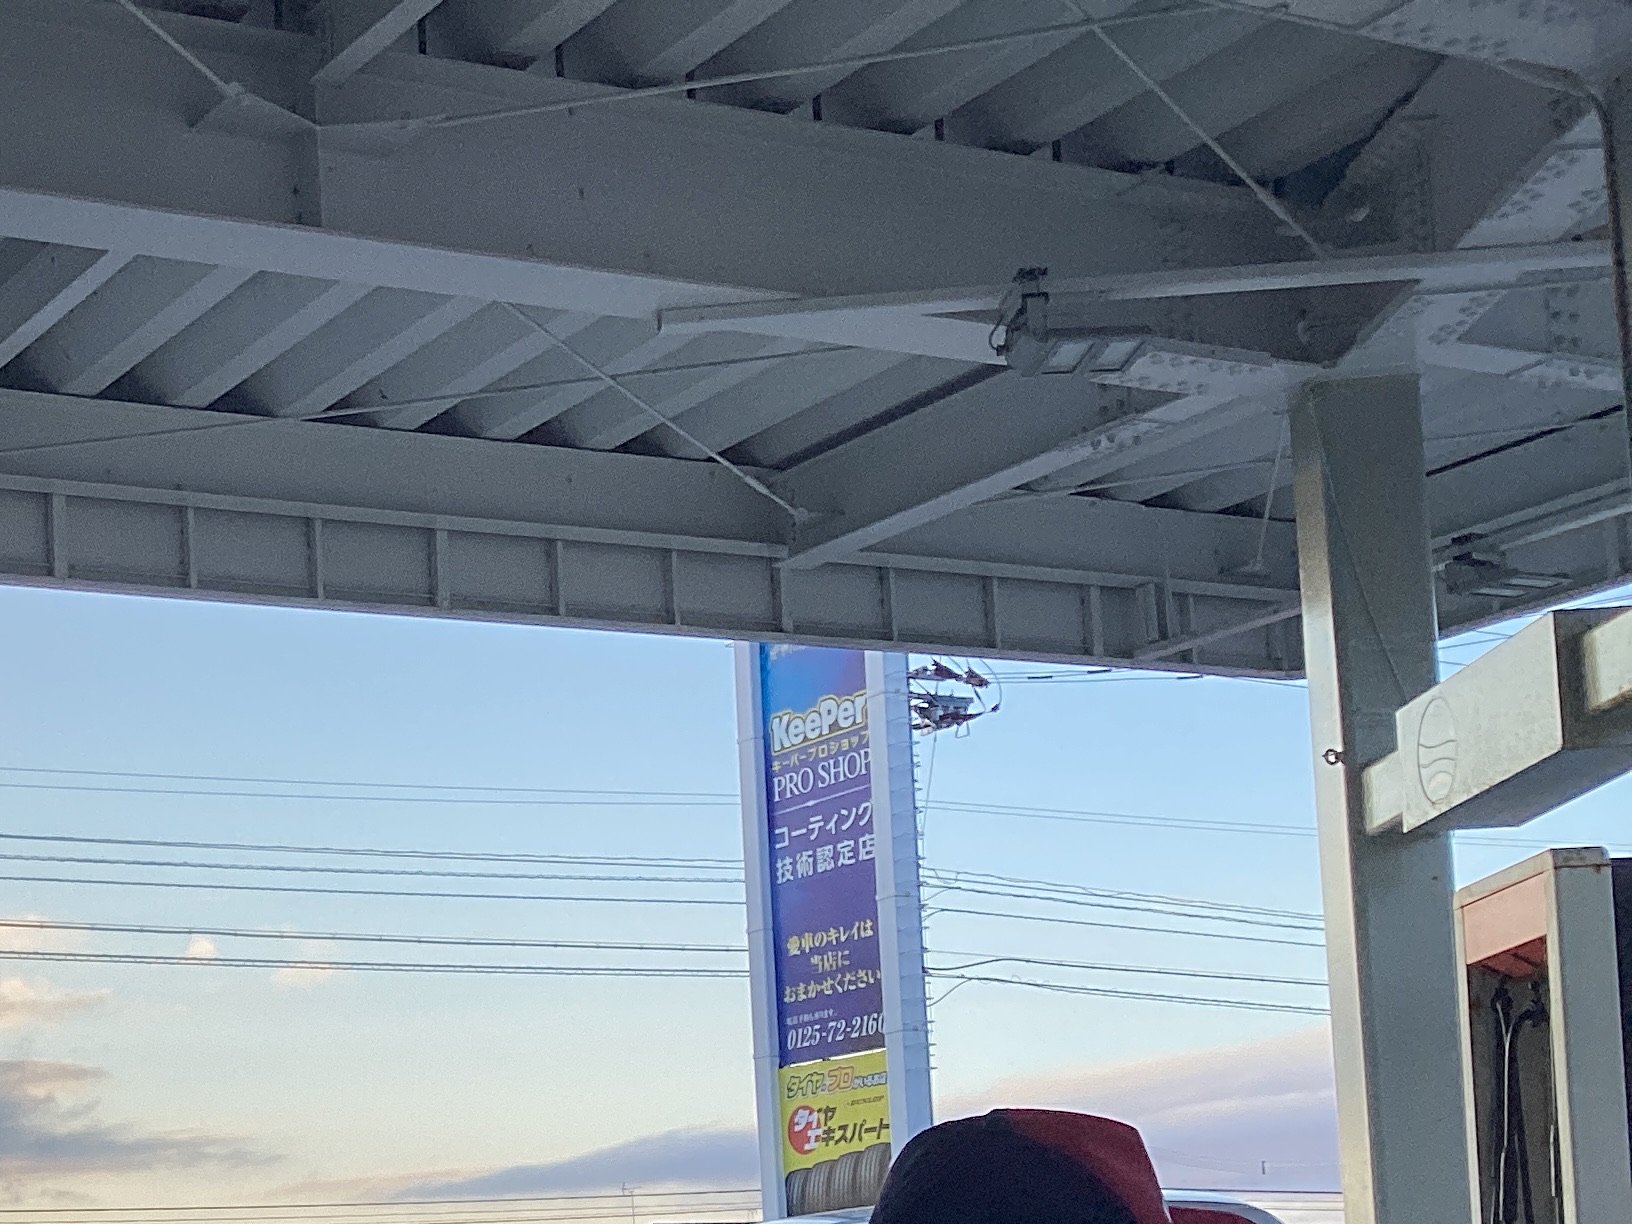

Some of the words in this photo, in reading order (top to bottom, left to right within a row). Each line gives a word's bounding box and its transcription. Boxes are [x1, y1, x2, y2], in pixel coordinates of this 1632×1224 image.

[770, 691, 868, 754] KeePer
[773, 767, 814, 802] PRO
[818, 748, 871, 789] SHOP
[774, 801, 873, 849] コーティング
[776, 834, 876, 885] 技術認定店
[786, 919, 874, 956] 愛車のキレイは
[783, 969, 881, 1004] おまかせください
[794, 1106, 837, 1132] タイヤ
[804, 1118, 890, 1151] エキスパート
